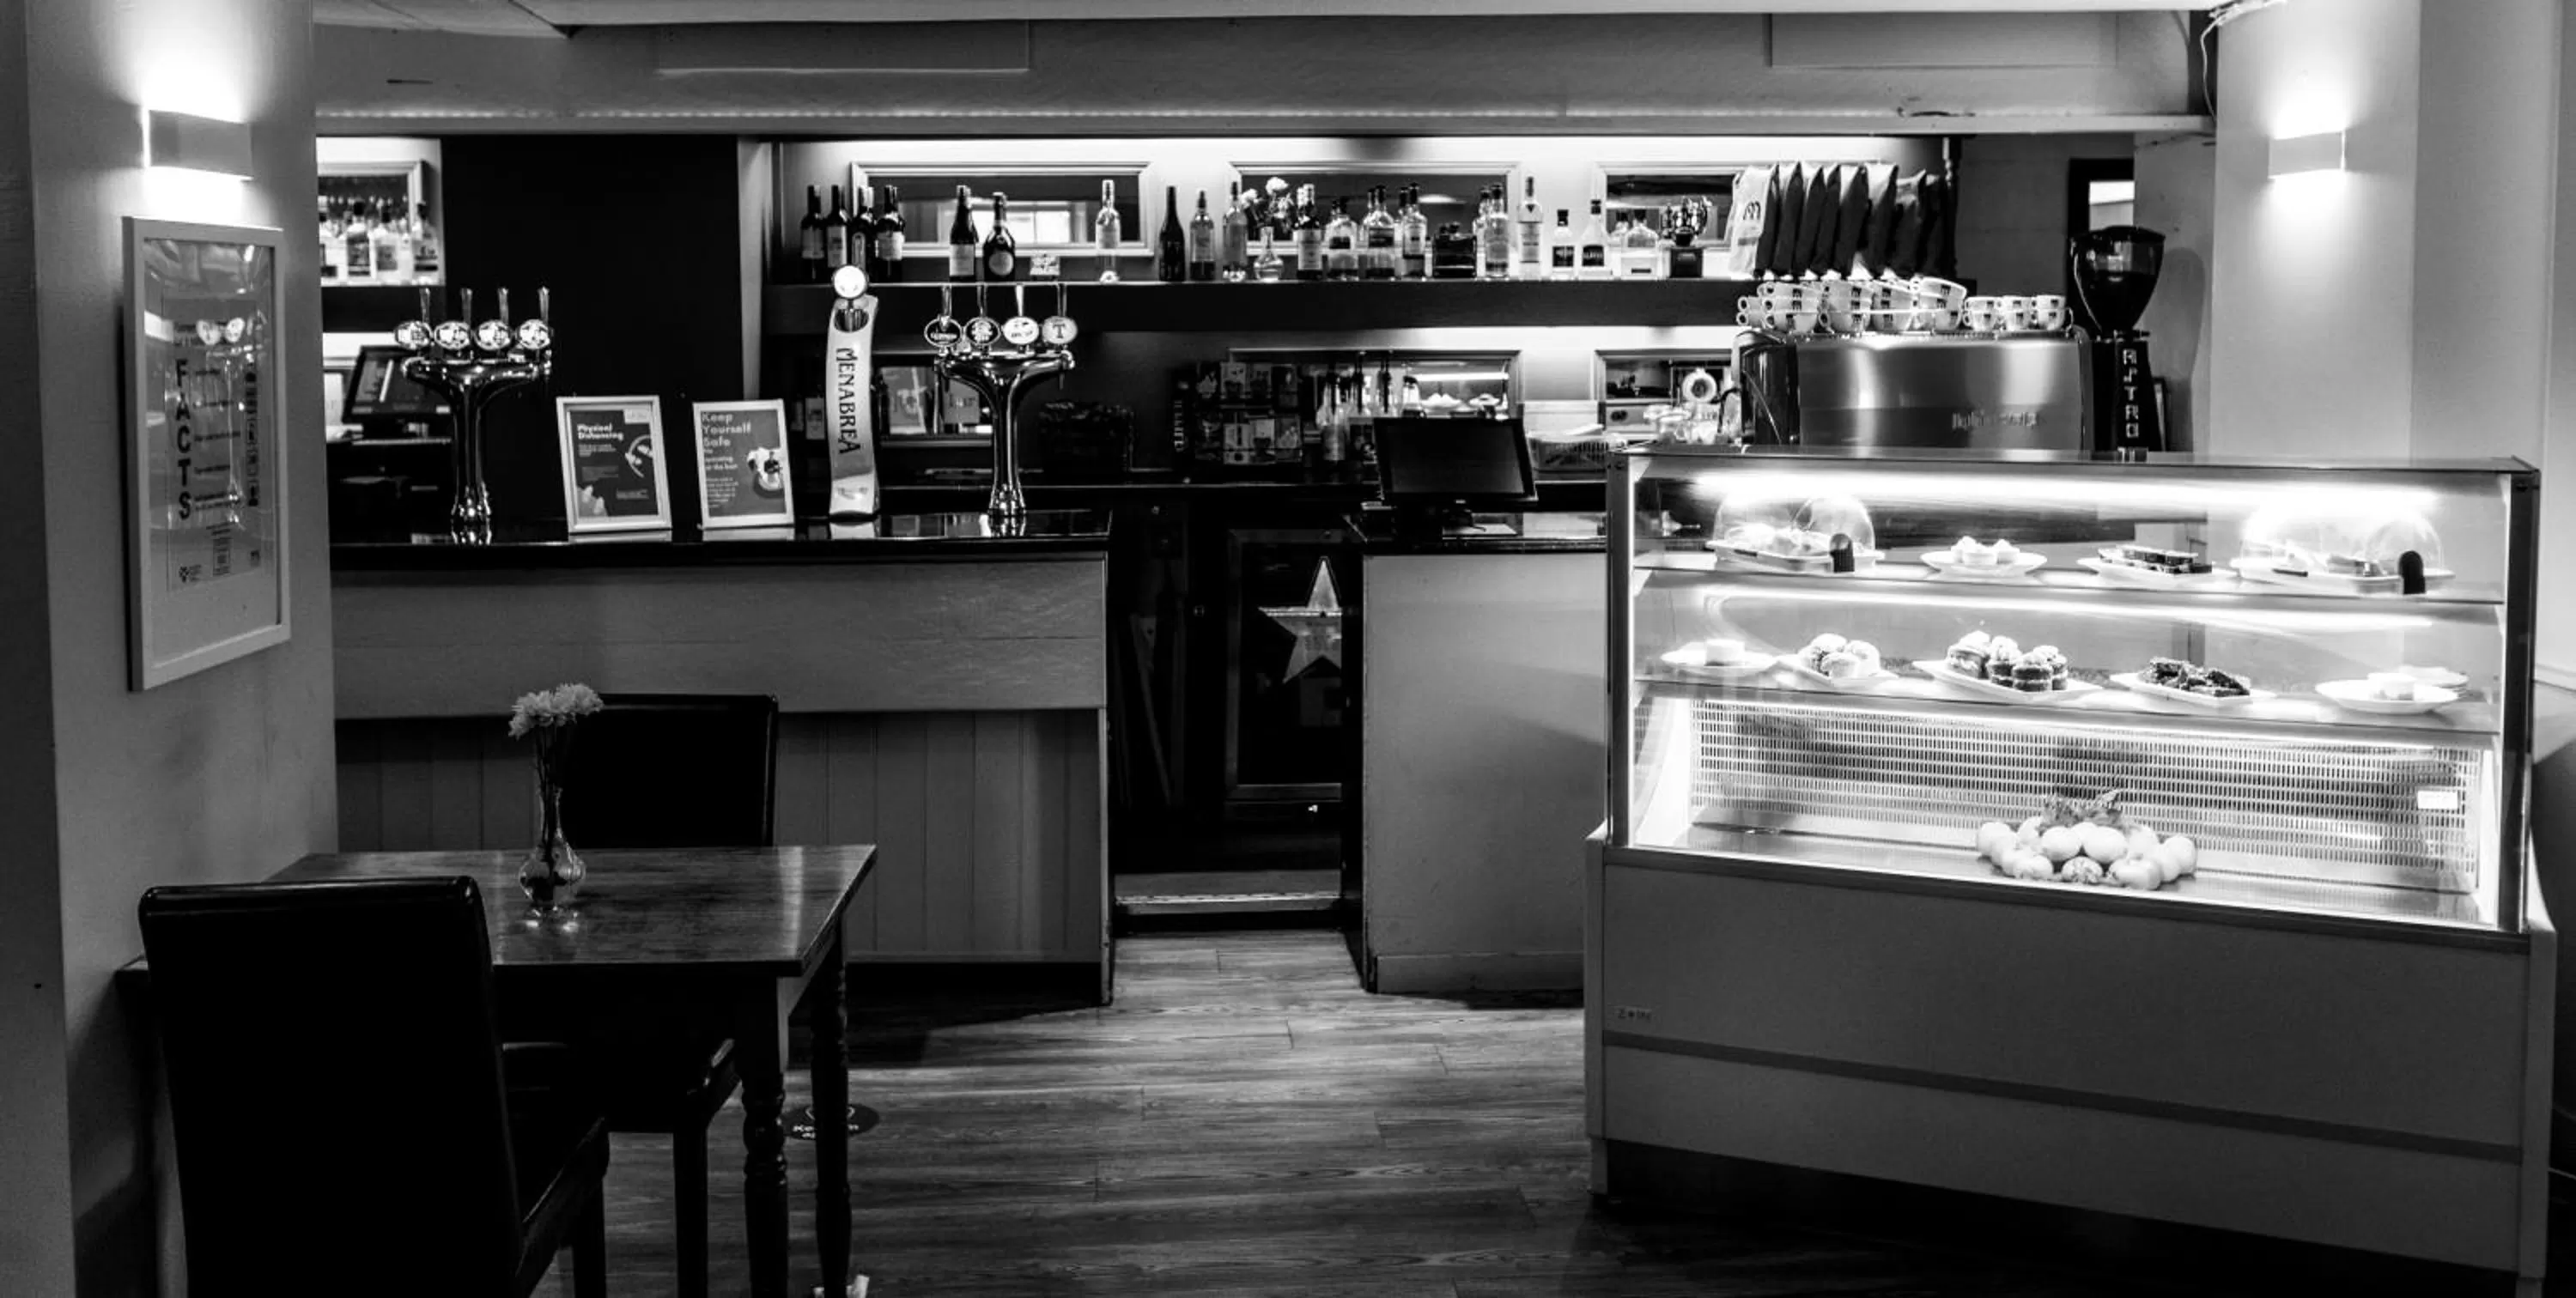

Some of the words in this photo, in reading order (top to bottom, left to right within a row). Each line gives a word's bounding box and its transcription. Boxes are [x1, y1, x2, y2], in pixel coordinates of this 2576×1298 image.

[835, 347, 861, 455] MENABREA
[702, 413, 733, 426] Keep
[576, 422, 613, 434] Physical
[702, 421, 752, 435] Yourself
[577, 432, 625, 442] Distancing
[703, 435, 732, 448] Safe
